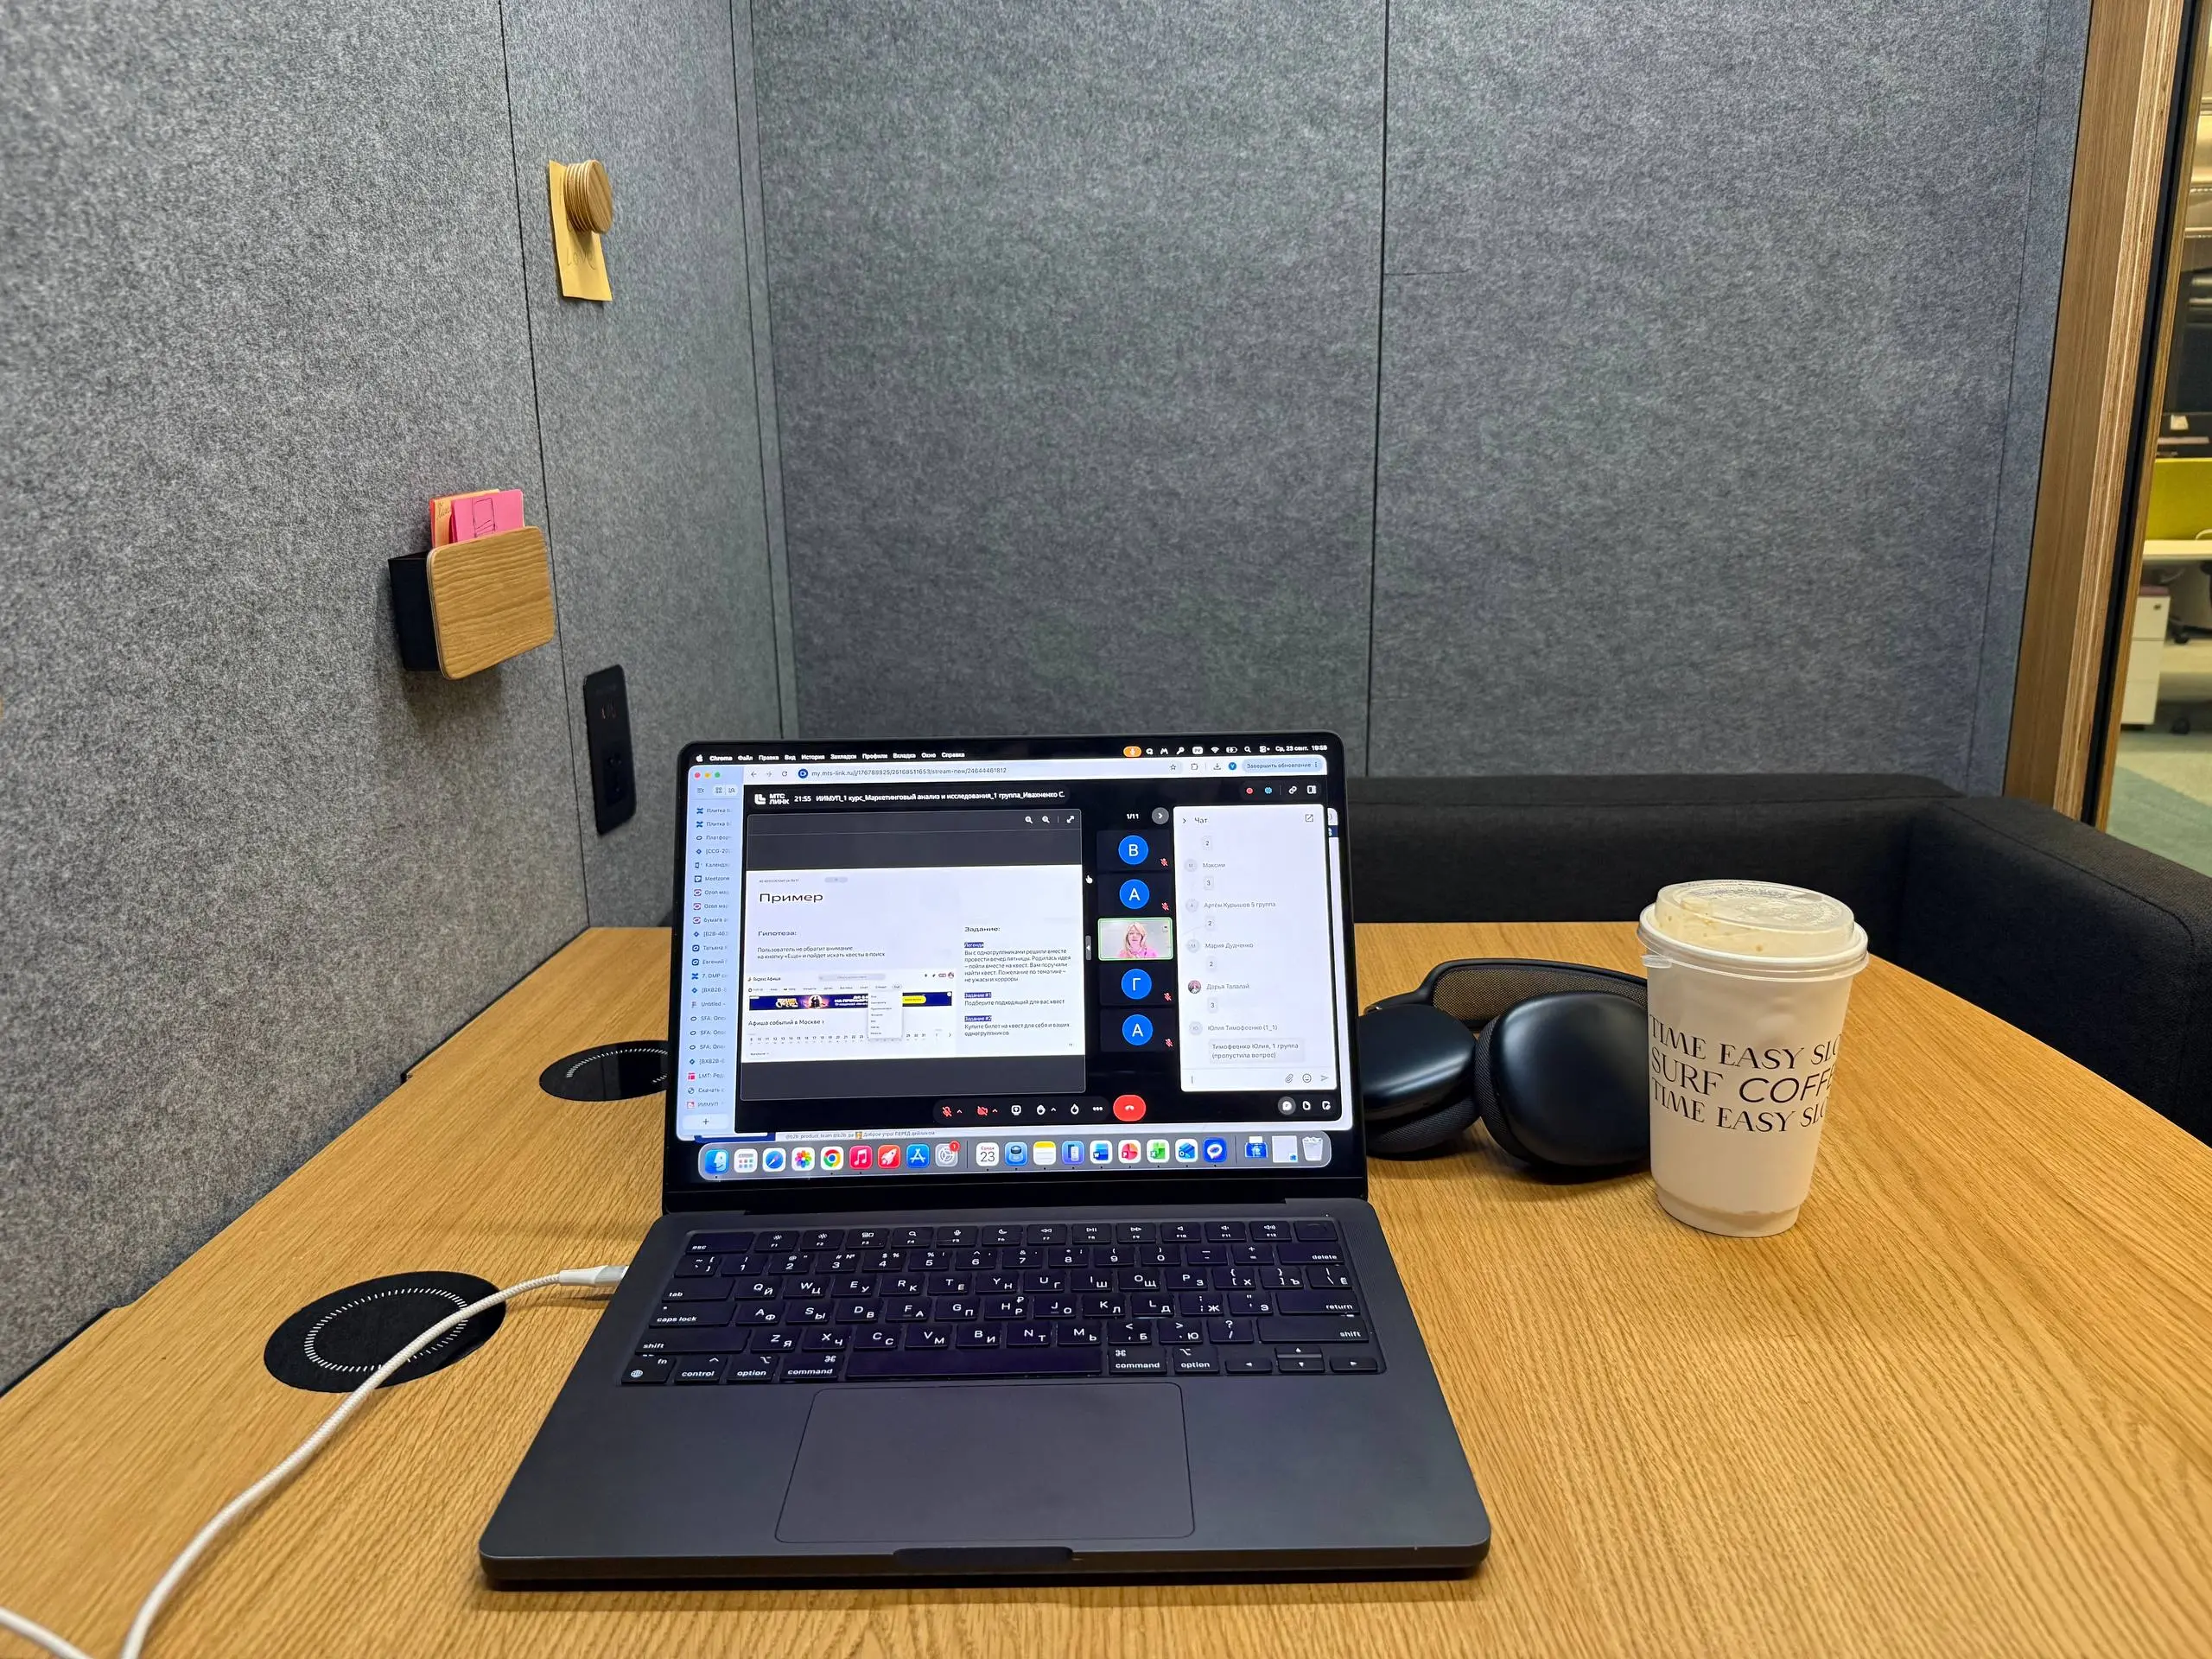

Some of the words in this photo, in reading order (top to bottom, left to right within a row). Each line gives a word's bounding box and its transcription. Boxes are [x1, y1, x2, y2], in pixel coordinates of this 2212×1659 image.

[760, 893, 823, 904] Пример
[1649, 1014, 1707, 1059] TIME
[1719, 1043, 1804, 1070] EASY
[1651, 1046, 1724, 1095] SURF
[1652, 1077, 1706, 1123] TIME
[1715, 1106, 1796, 1132] EASY
[980, 1151, 995, 1162] 23
[771, 1334, 781, 1343] Z
[974, 1330, 983, 1338] B
